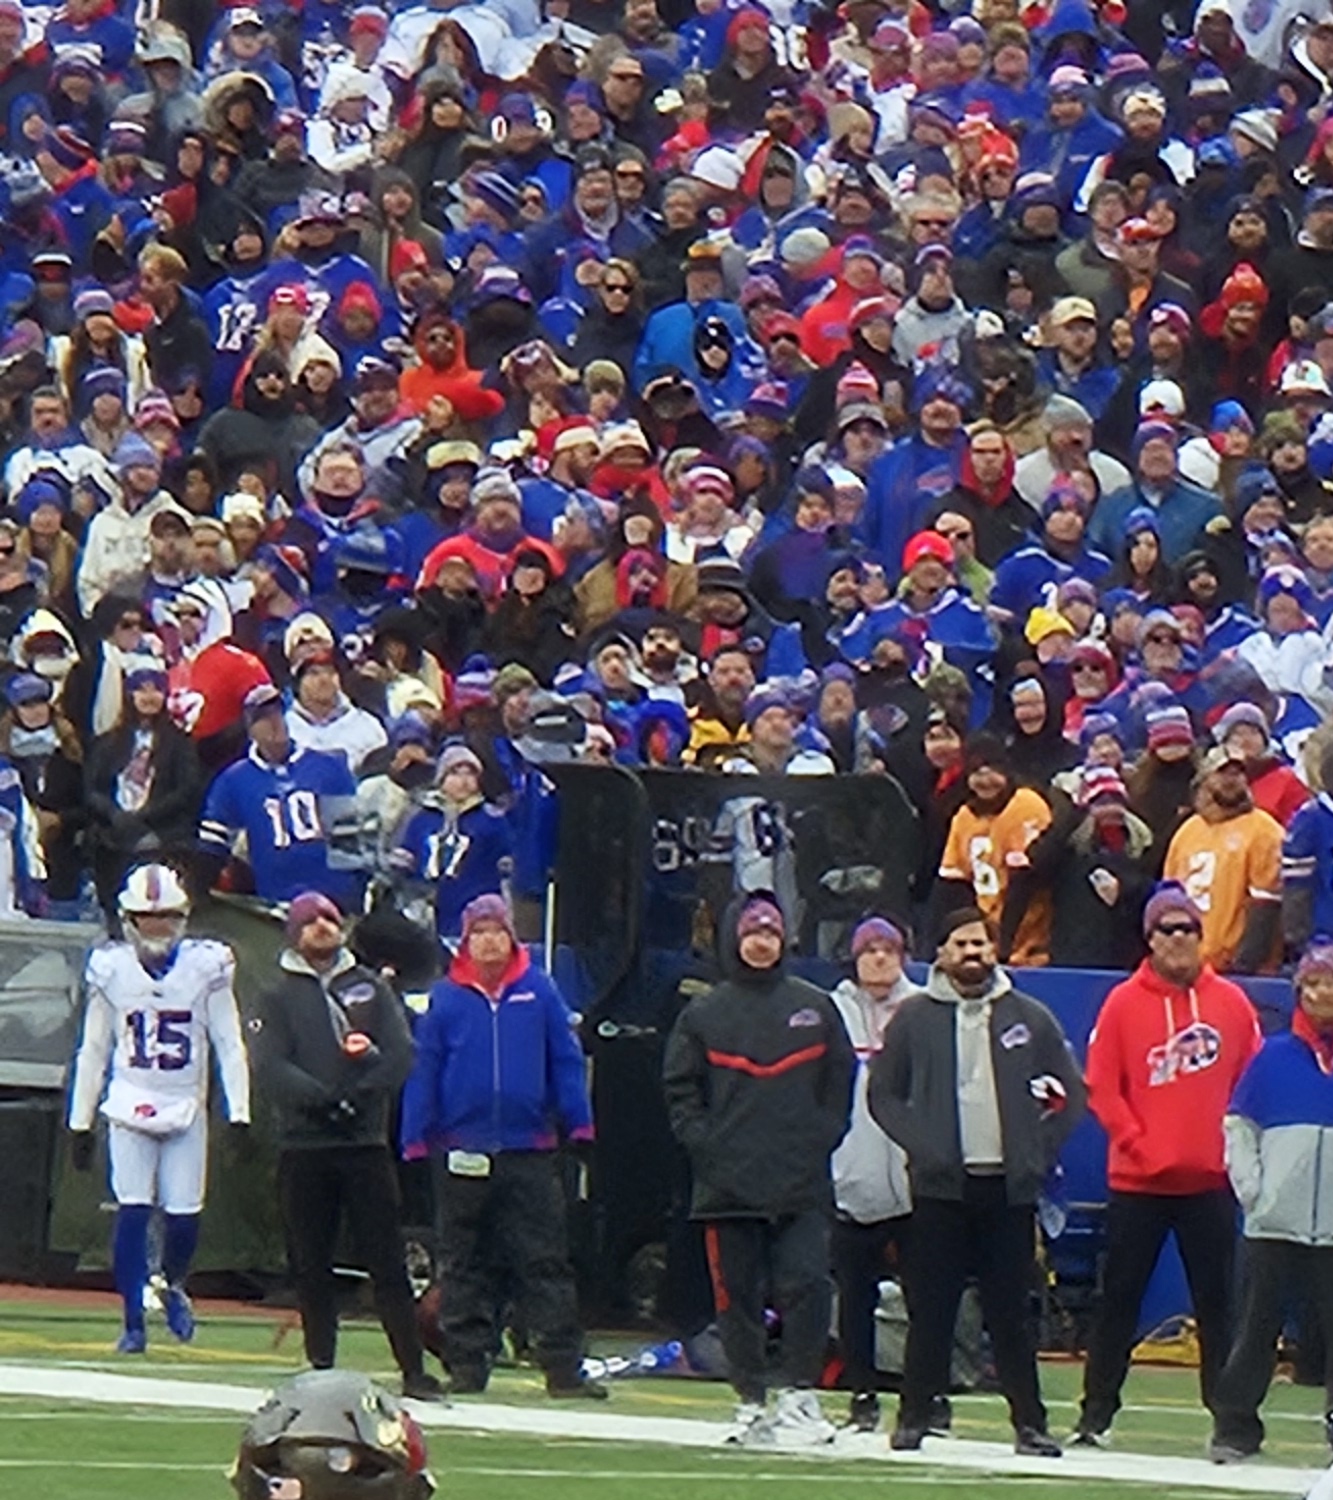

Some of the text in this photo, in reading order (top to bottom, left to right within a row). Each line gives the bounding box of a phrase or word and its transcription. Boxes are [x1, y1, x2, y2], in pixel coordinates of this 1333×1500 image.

[264, 790, 321, 847] 10
[426, 833, 471, 880] 17
[125, 1010, 192, 1070] 15
